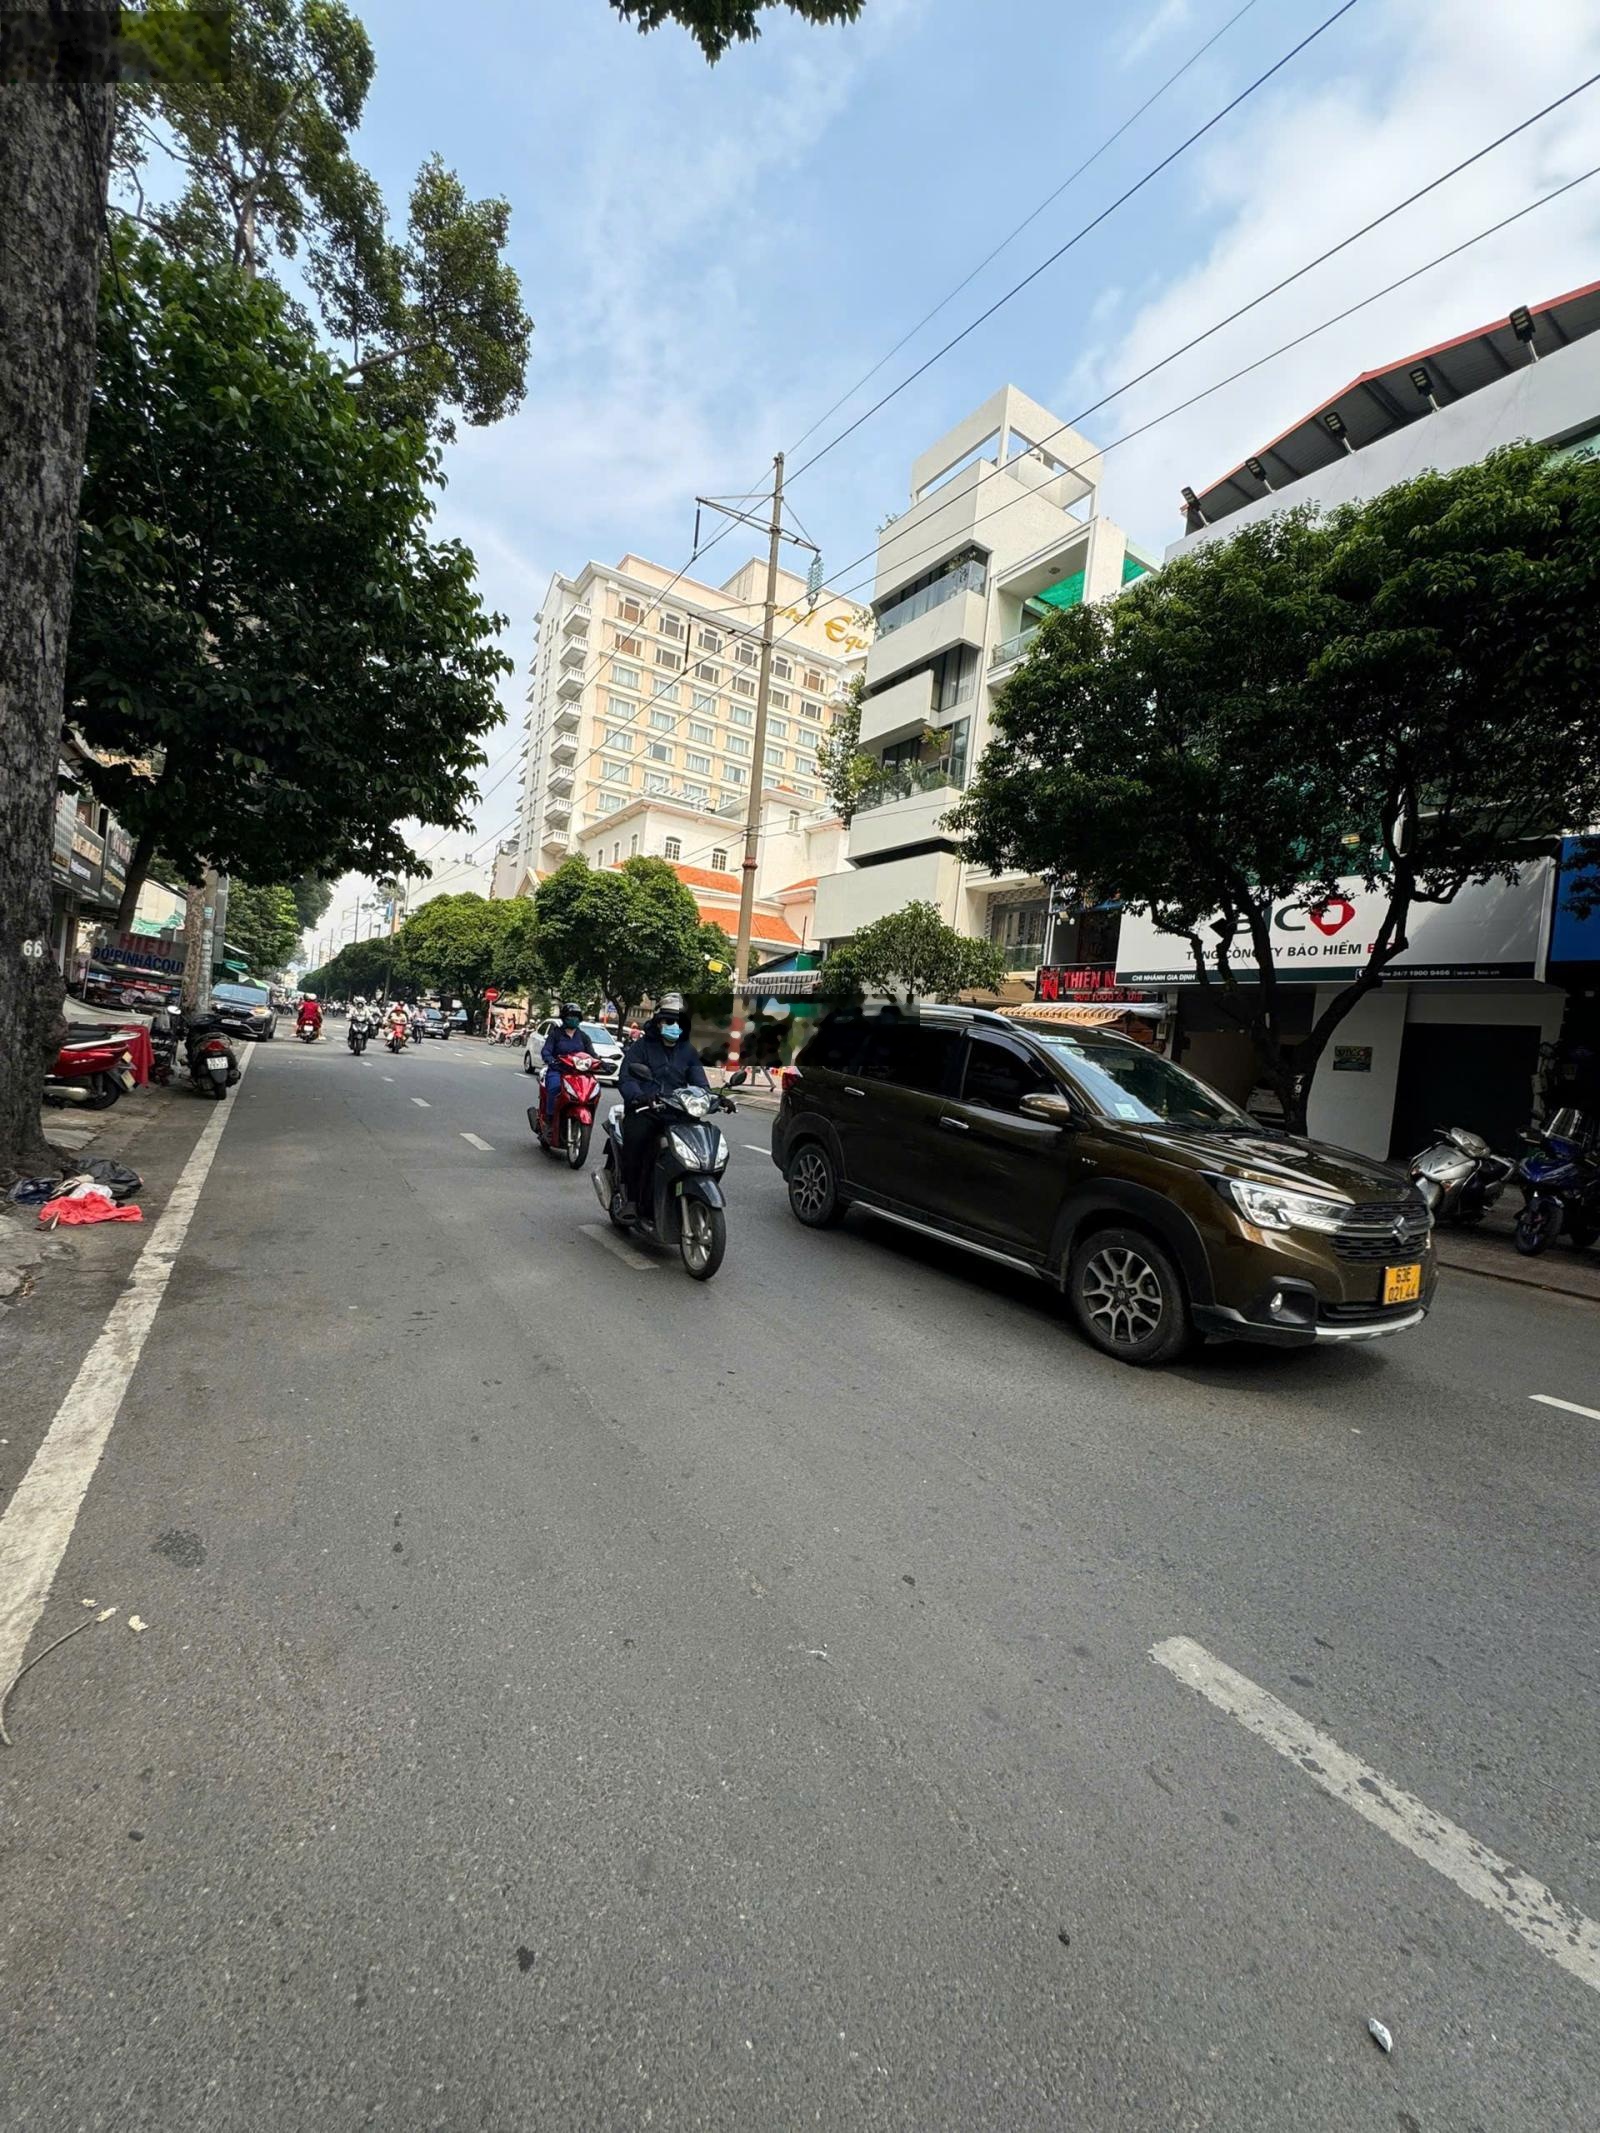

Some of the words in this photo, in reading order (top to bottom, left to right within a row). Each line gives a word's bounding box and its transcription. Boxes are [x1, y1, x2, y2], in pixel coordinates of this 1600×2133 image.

[23, 940, 43, 957] 66
[1186, 950, 1220, 961] TNG
[1287, 943, 1319, 957] BẢO
[1323, 939, 1362, 955] HIỂM
[1131, 974, 1143, 982] CHI
[1143, 973, 1166, 981] NHÁNH
[1179, 973, 1196, 982] ĐỊNH
